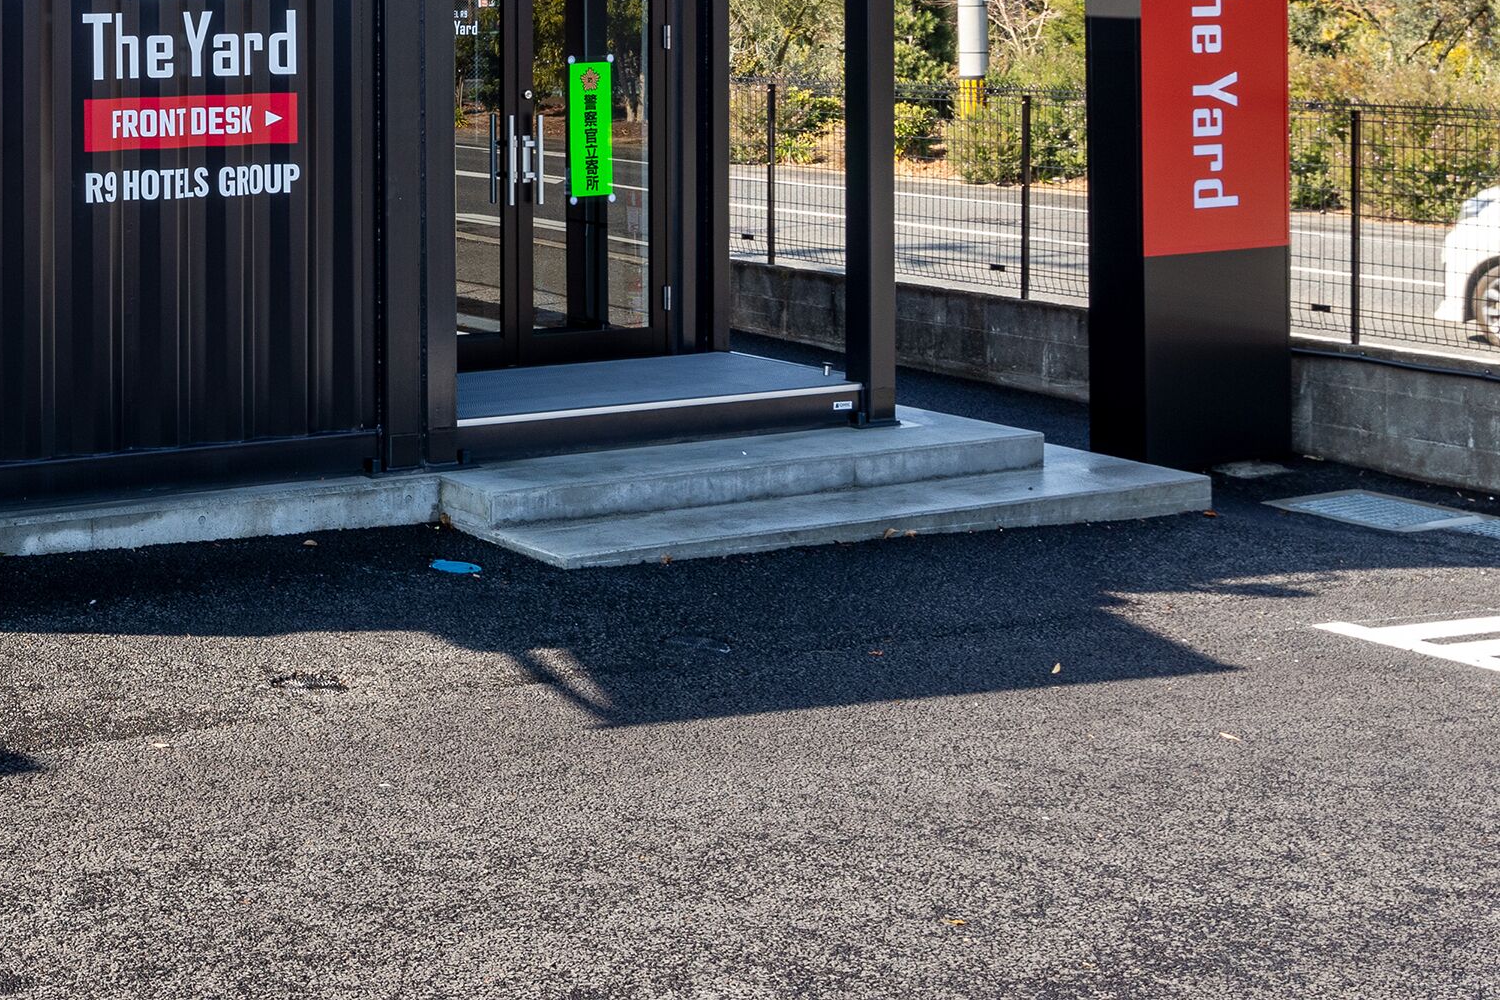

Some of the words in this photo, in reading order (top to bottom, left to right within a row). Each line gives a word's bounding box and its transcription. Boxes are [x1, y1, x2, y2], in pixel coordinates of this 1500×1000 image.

[82, 12, 174, 81] The
[182, 9, 297, 78] Yard
[453, 20, 478, 36] Yard
[111, 107, 187, 139] FRONT
[191, 105, 253, 135] DESK
[583, 93, 599, 192] 警察官立寄所
[1191, 71, 1240, 209] Yard
[85, 171, 118, 204] R9
[123, 167, 210, 201] HOTELS
[218, 163, 301, 197] GROUP
